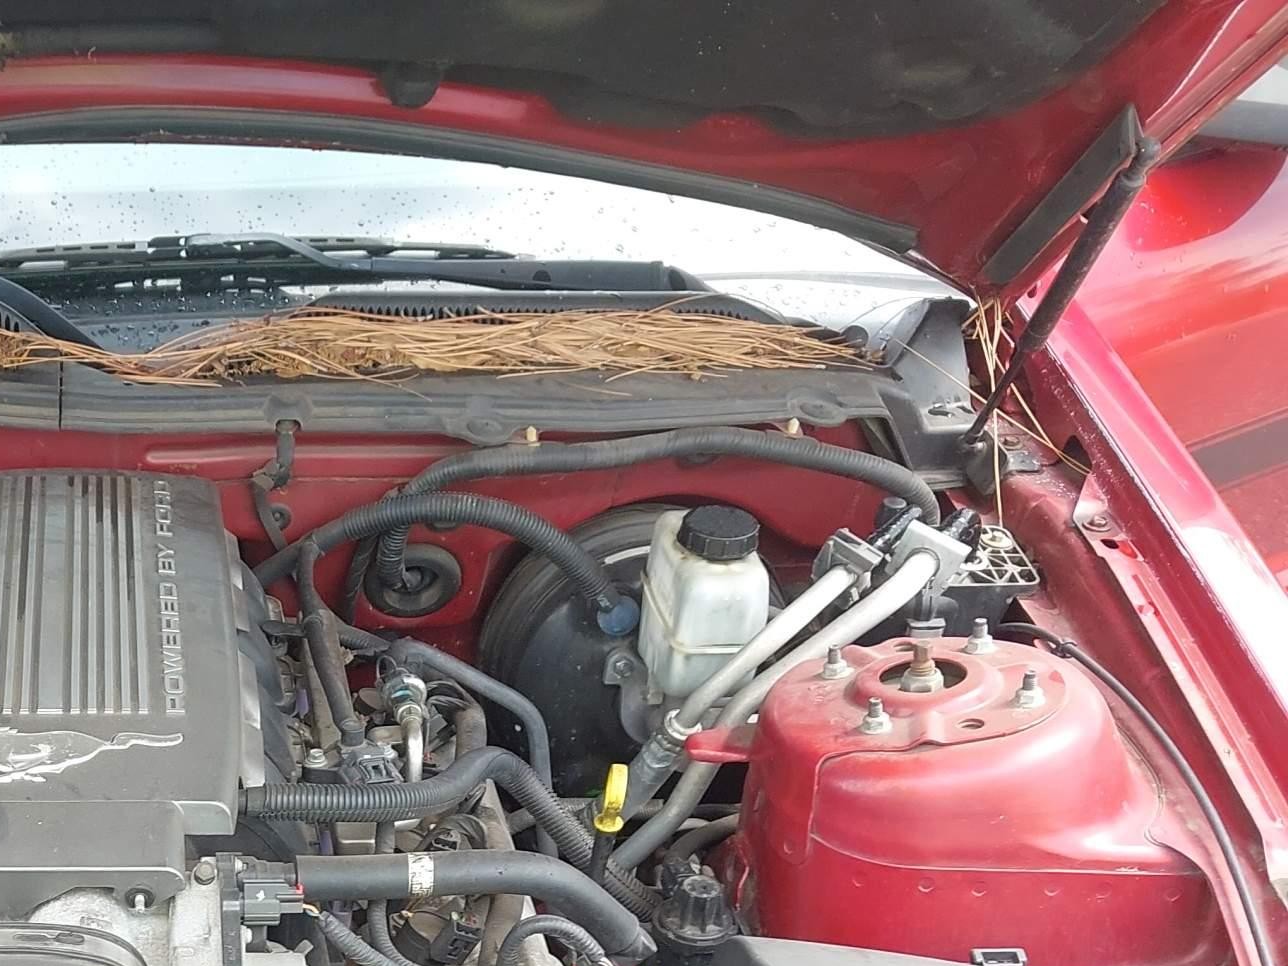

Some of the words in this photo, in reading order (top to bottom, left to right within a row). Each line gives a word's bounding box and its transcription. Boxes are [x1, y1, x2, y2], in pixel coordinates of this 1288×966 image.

[153, 480, 173, 538] FORD
[156, 544, 177, 580] BY
[159, 582, 185, 715] POWERED
